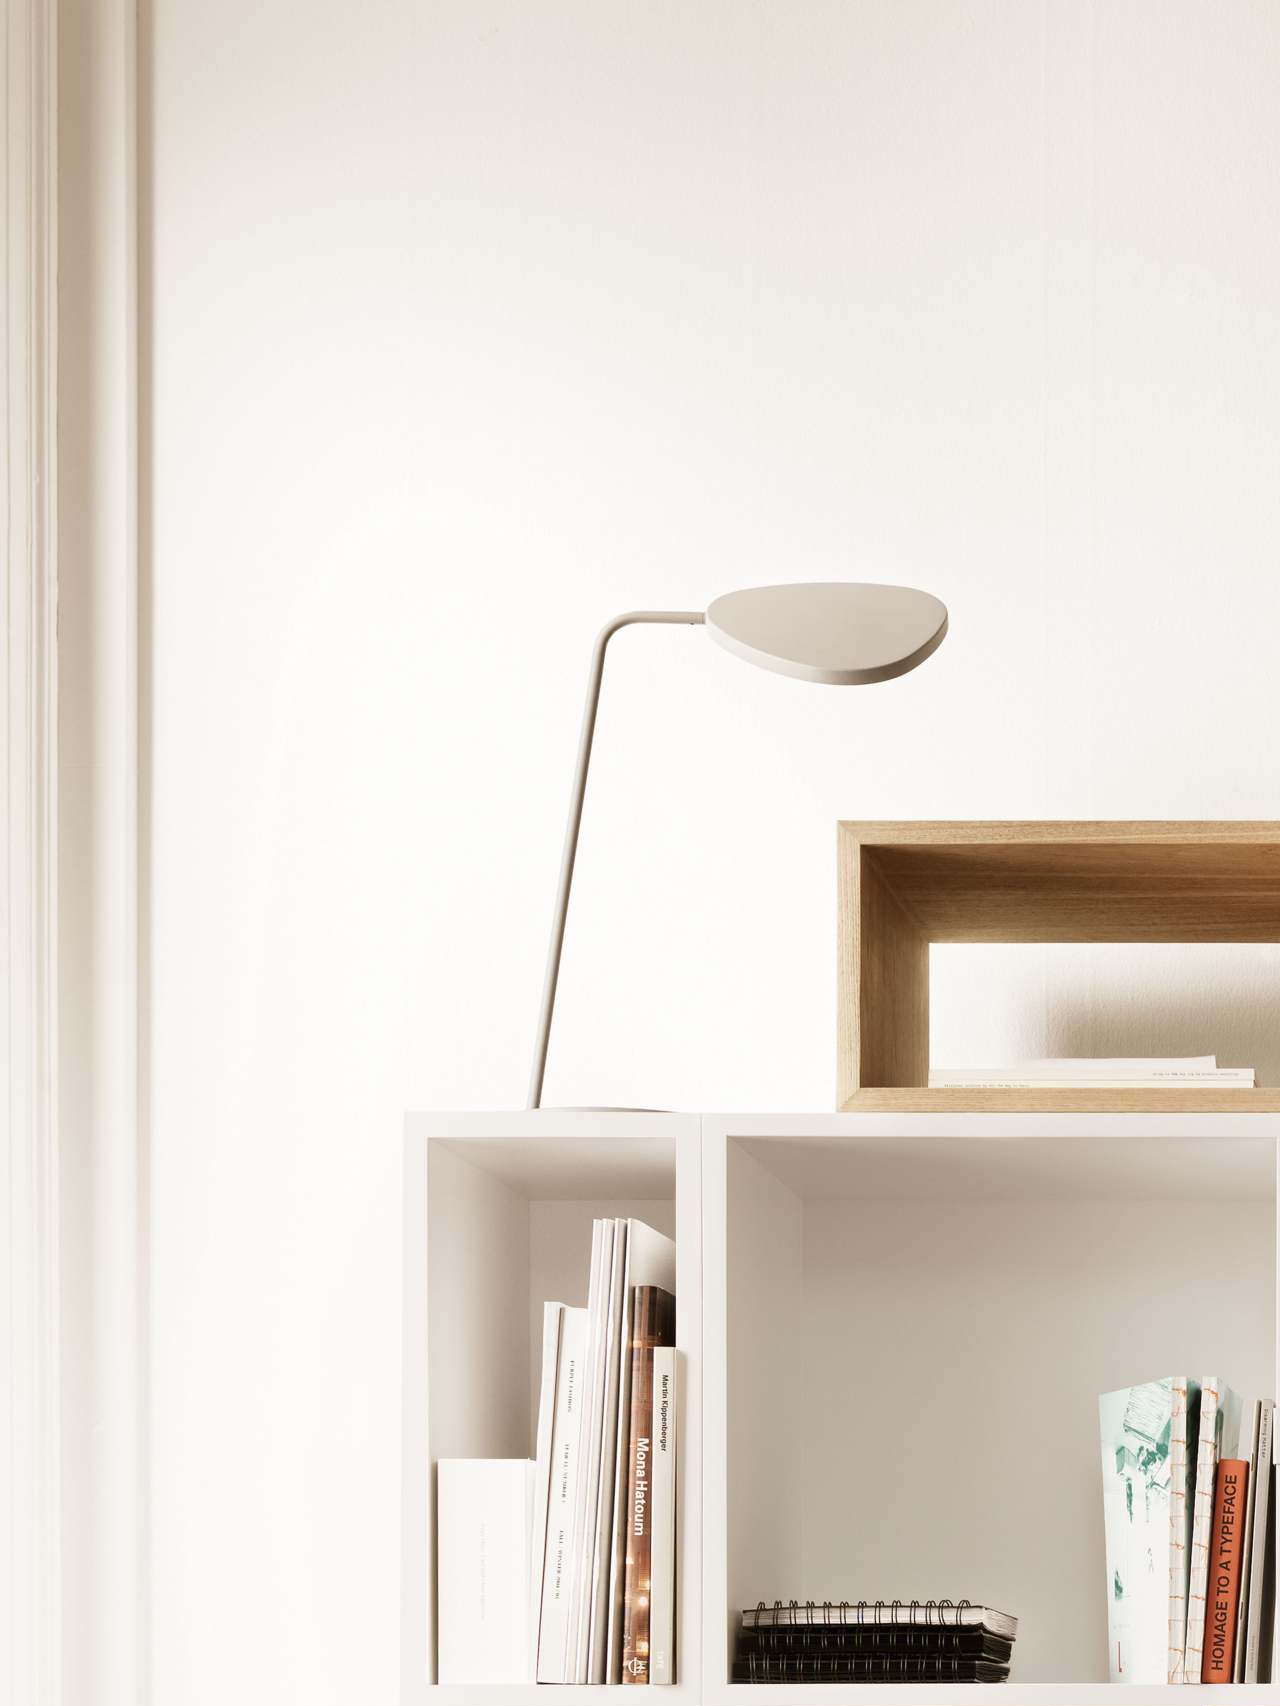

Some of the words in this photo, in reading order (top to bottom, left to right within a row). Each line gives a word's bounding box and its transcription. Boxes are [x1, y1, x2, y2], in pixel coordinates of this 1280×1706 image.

[660, 1401, 669, 1452] Kippenberger
[636, 1438, 649, 1478] Mona
[634, 1481, 648, 1536] Hatoum
[1220, 1474, 1237, 1556] TYPEFACE
[1217, 1576, 1230, 1596] TO
[1219, 1560, 1231, 1571] A
[1211, 1601, 1228, 1671] HOMAGE
